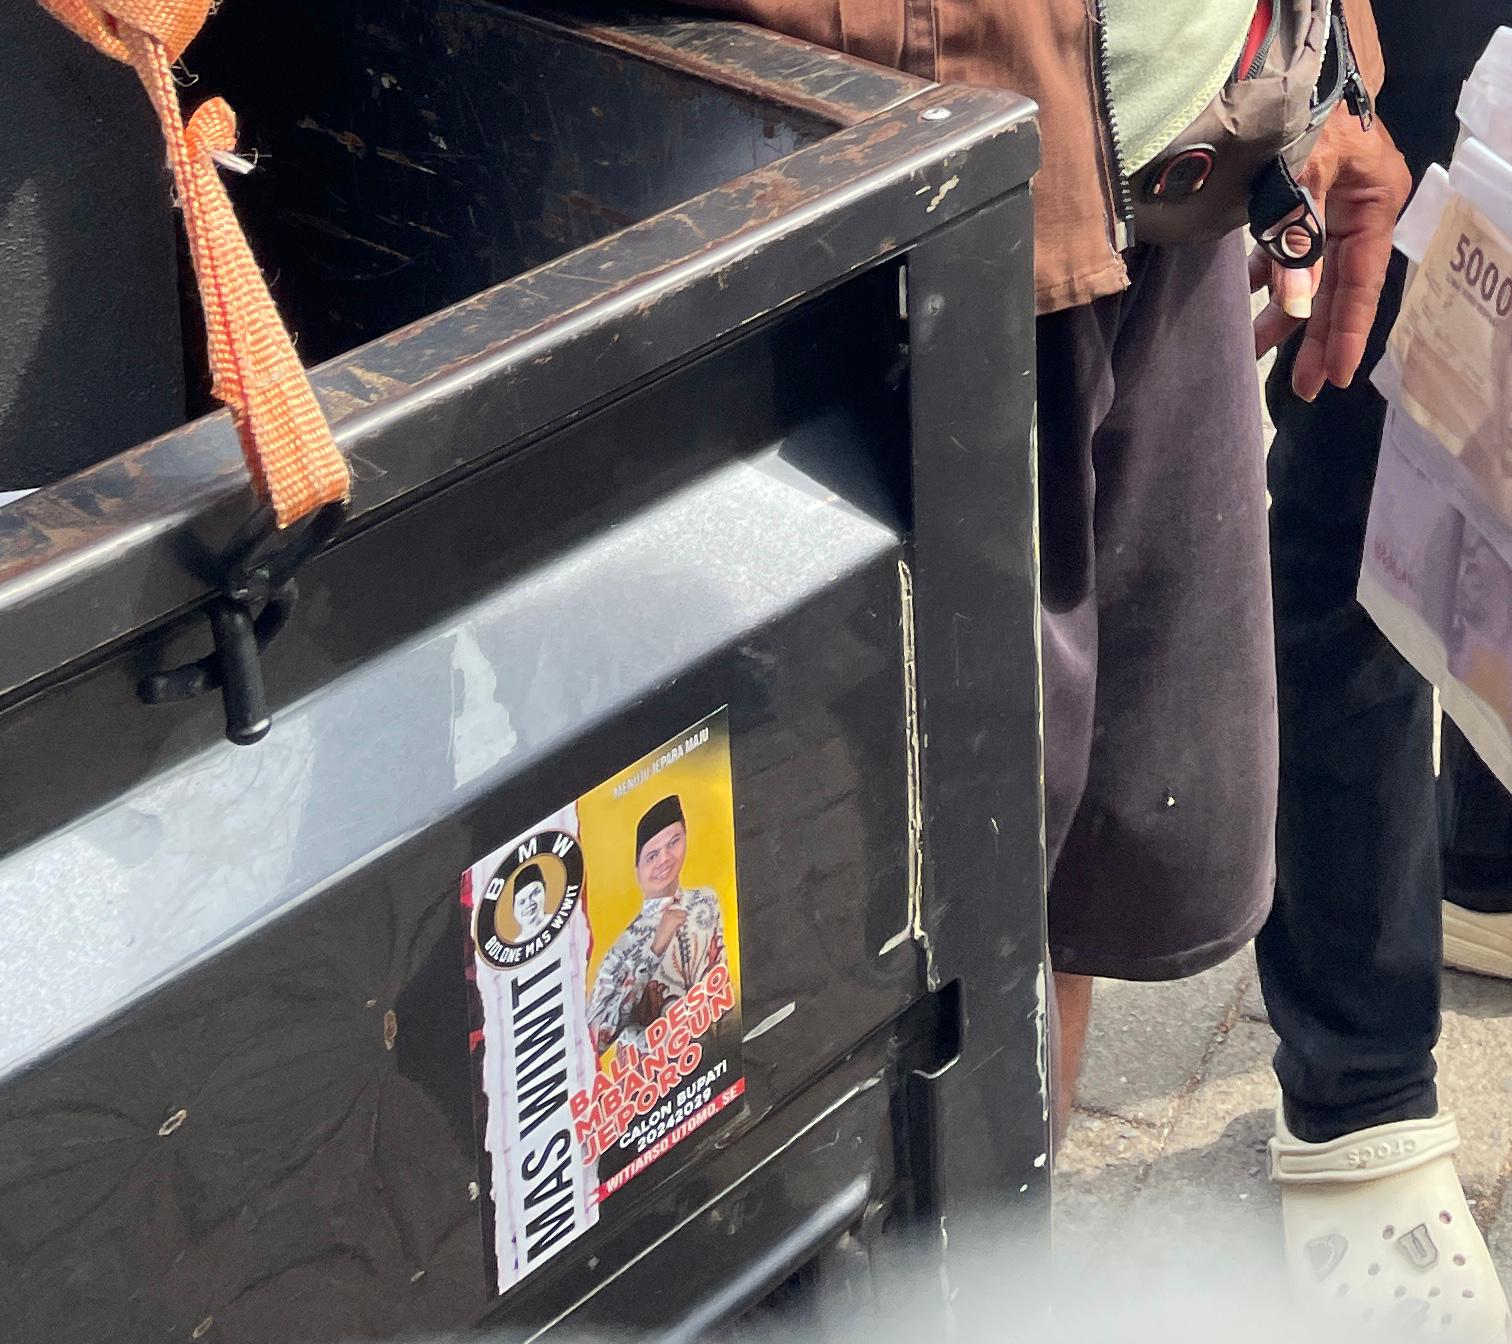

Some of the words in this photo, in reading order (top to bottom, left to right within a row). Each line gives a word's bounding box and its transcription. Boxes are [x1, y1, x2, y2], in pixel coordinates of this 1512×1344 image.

[651, 745, 684, 776] JEPARA
[484, 935, 523, 963] BOLONE
[525, 930, 551, 958] MAS
[551, 885, 579, 929] WIWIT
[510, 957, 569, 1141] WIWIT
[569, 1046, 640, 1120] BALI
[645, 964, 728, 1050] DESO
[575, 983, 735, 1143] MBANGUN
[582, 1042, 702, 1167] JEPORO
[619, 1101, 671, 1149] CALON
[676, 1059, 727, 1108] BUPATI
[521, 1128, 577, 1263] MAS
[606, 1139, 669, 1193] WITIARSO
